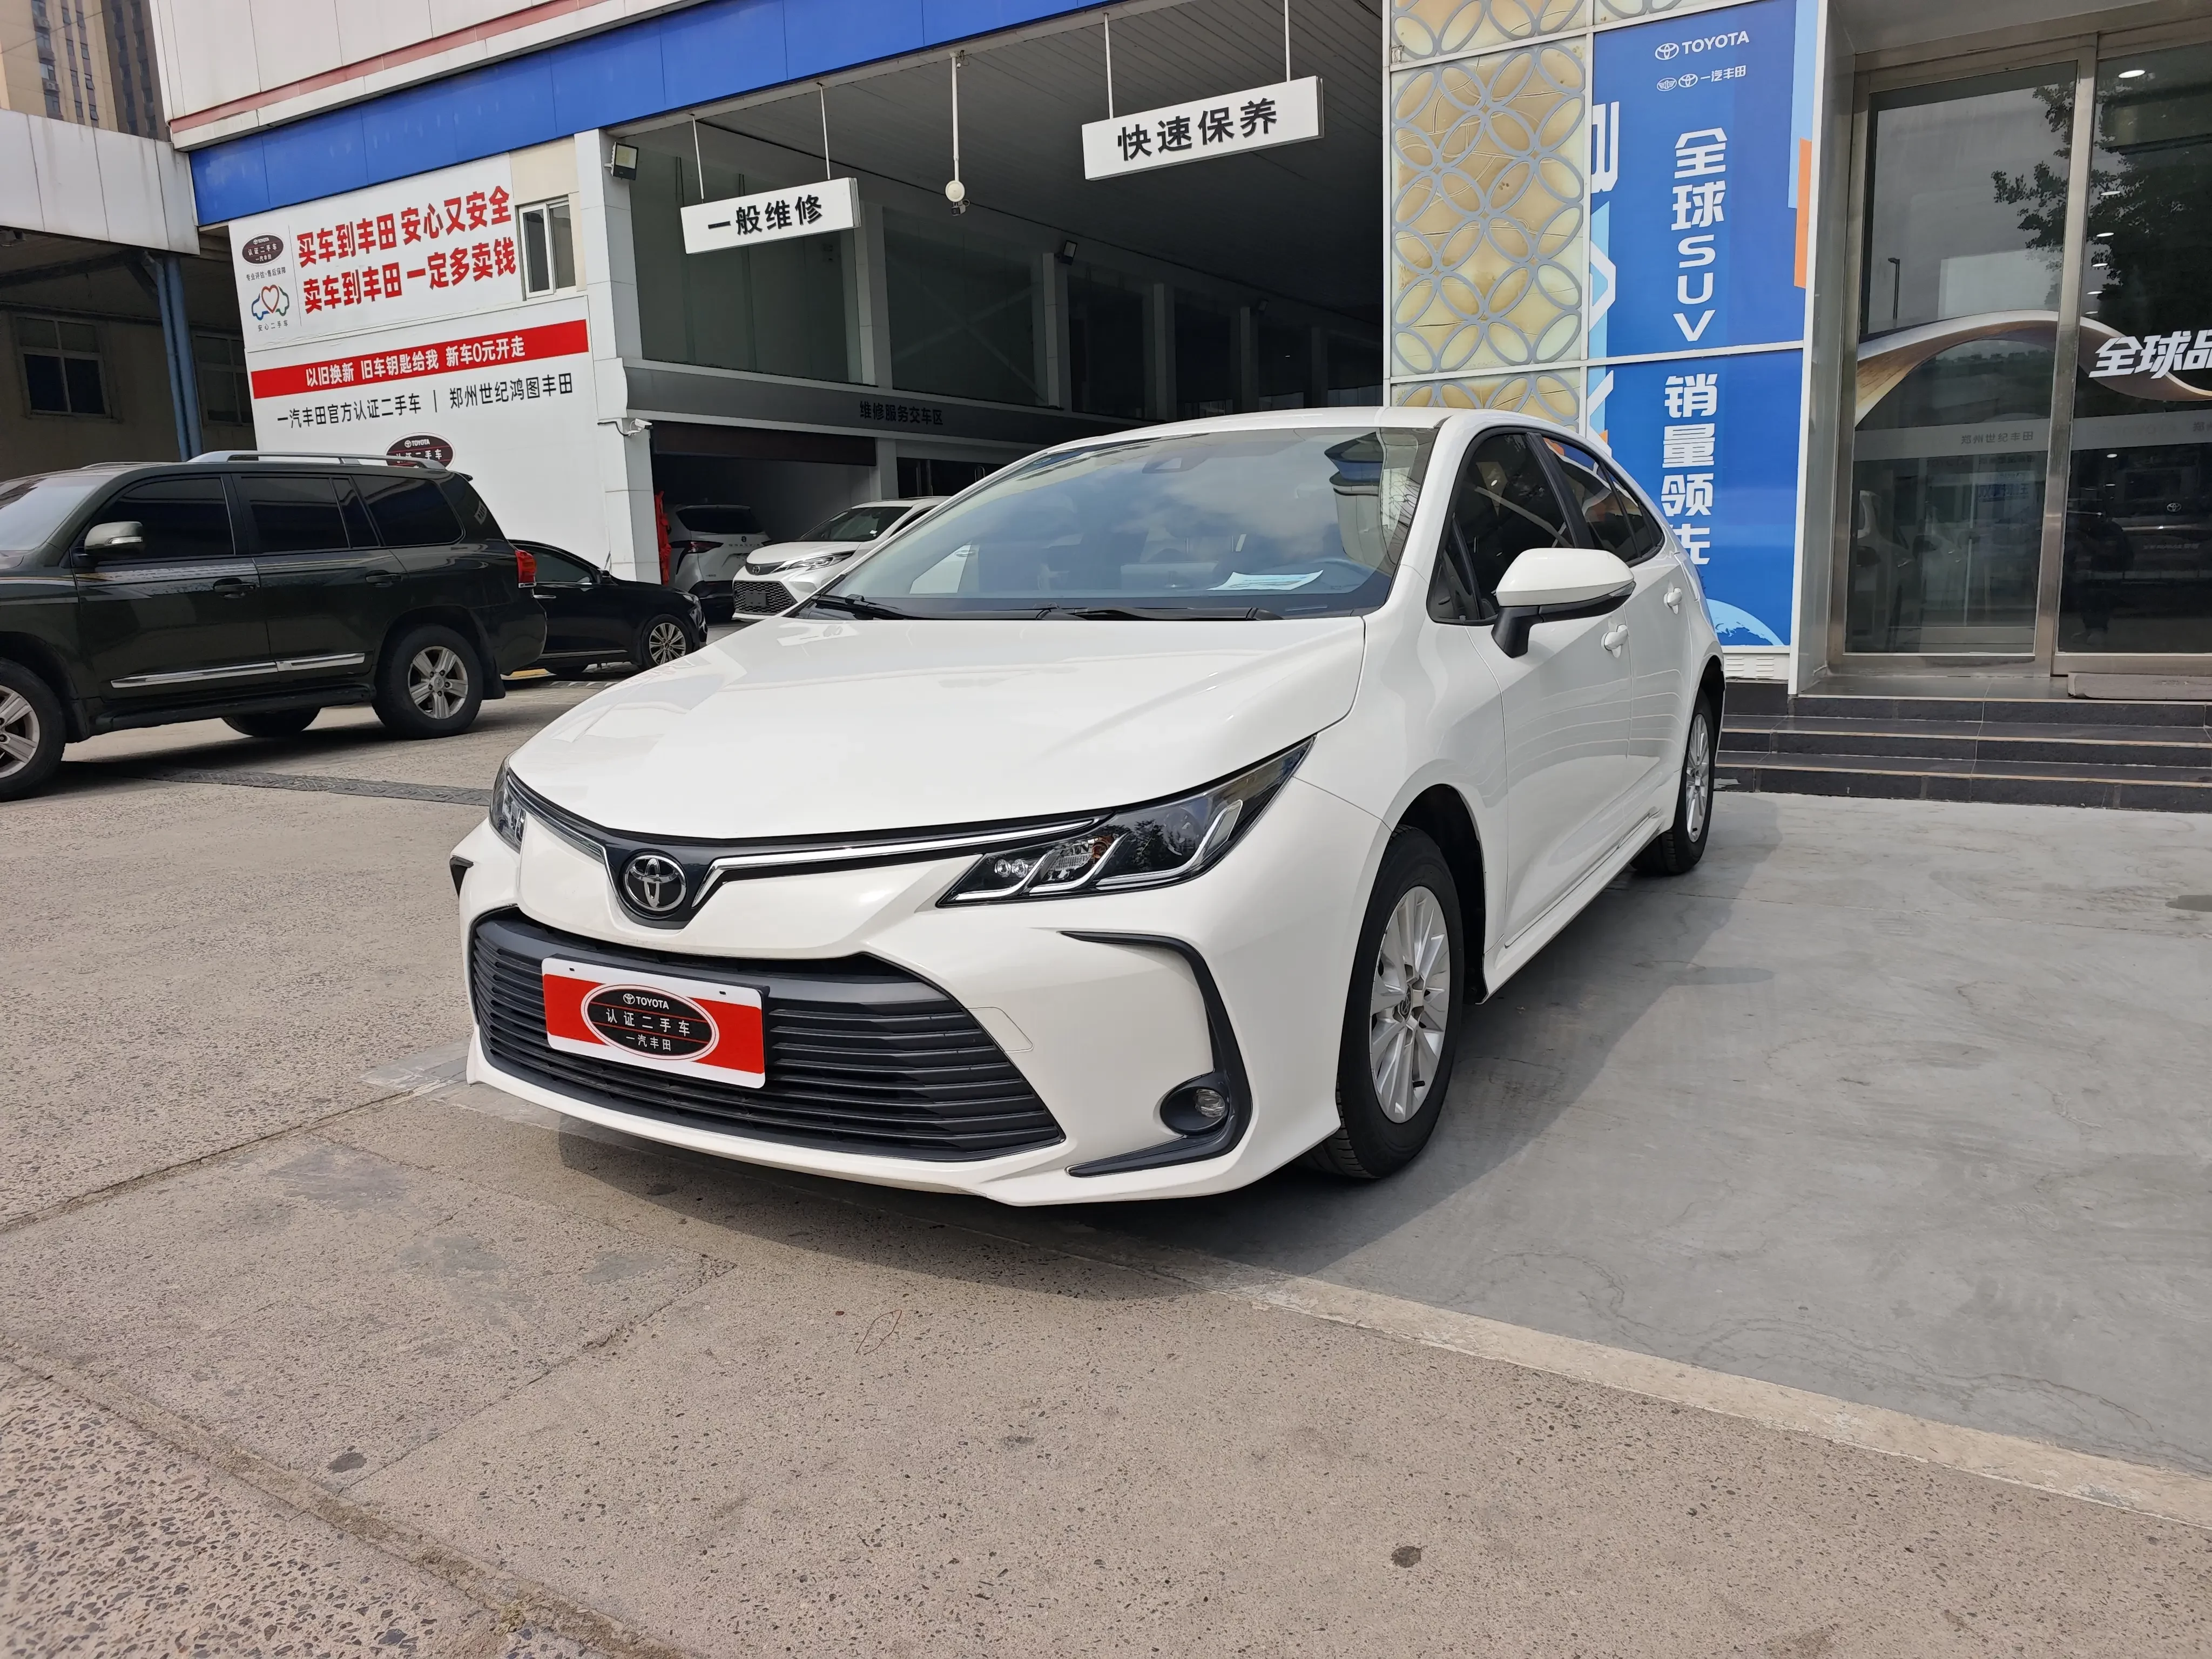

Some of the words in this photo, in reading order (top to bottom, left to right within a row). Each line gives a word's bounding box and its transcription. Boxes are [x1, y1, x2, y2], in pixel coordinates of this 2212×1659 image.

[1682, 31, 1750, 55] TOYOTA
[1701, 65, 1746, 82] 一汽丰田
[1117, 97, 1277, 161] 快速保养
[708, 194, 822, 235] 一般维修
[247, 243, 278, 256] 认证二手车
[258, 320, 288, 332] 安心二手车
[306, 362, 354, 387] 以旧换新
[361, 350, 439, 380] 旧车钥匙给我
[446, 335, 525, 367] 新车0元开走
[277, 393, 422, 428] 一汽丰田官方认证二手车
[449, 373, 573, 409] 郑州世纪鸿图丰田
[860, 401, 943, 426] 维修服务交车区
[412, 439, 430, 447] TOYOTA
[1961, 431, 2034, 444] 郑州世纪丰田
[636, 996, 669, 1010] TOYOTA
[605, 1008, 691, 1036] 认证二手车
[626, 1034, 671, 1051] 一汽丰田
